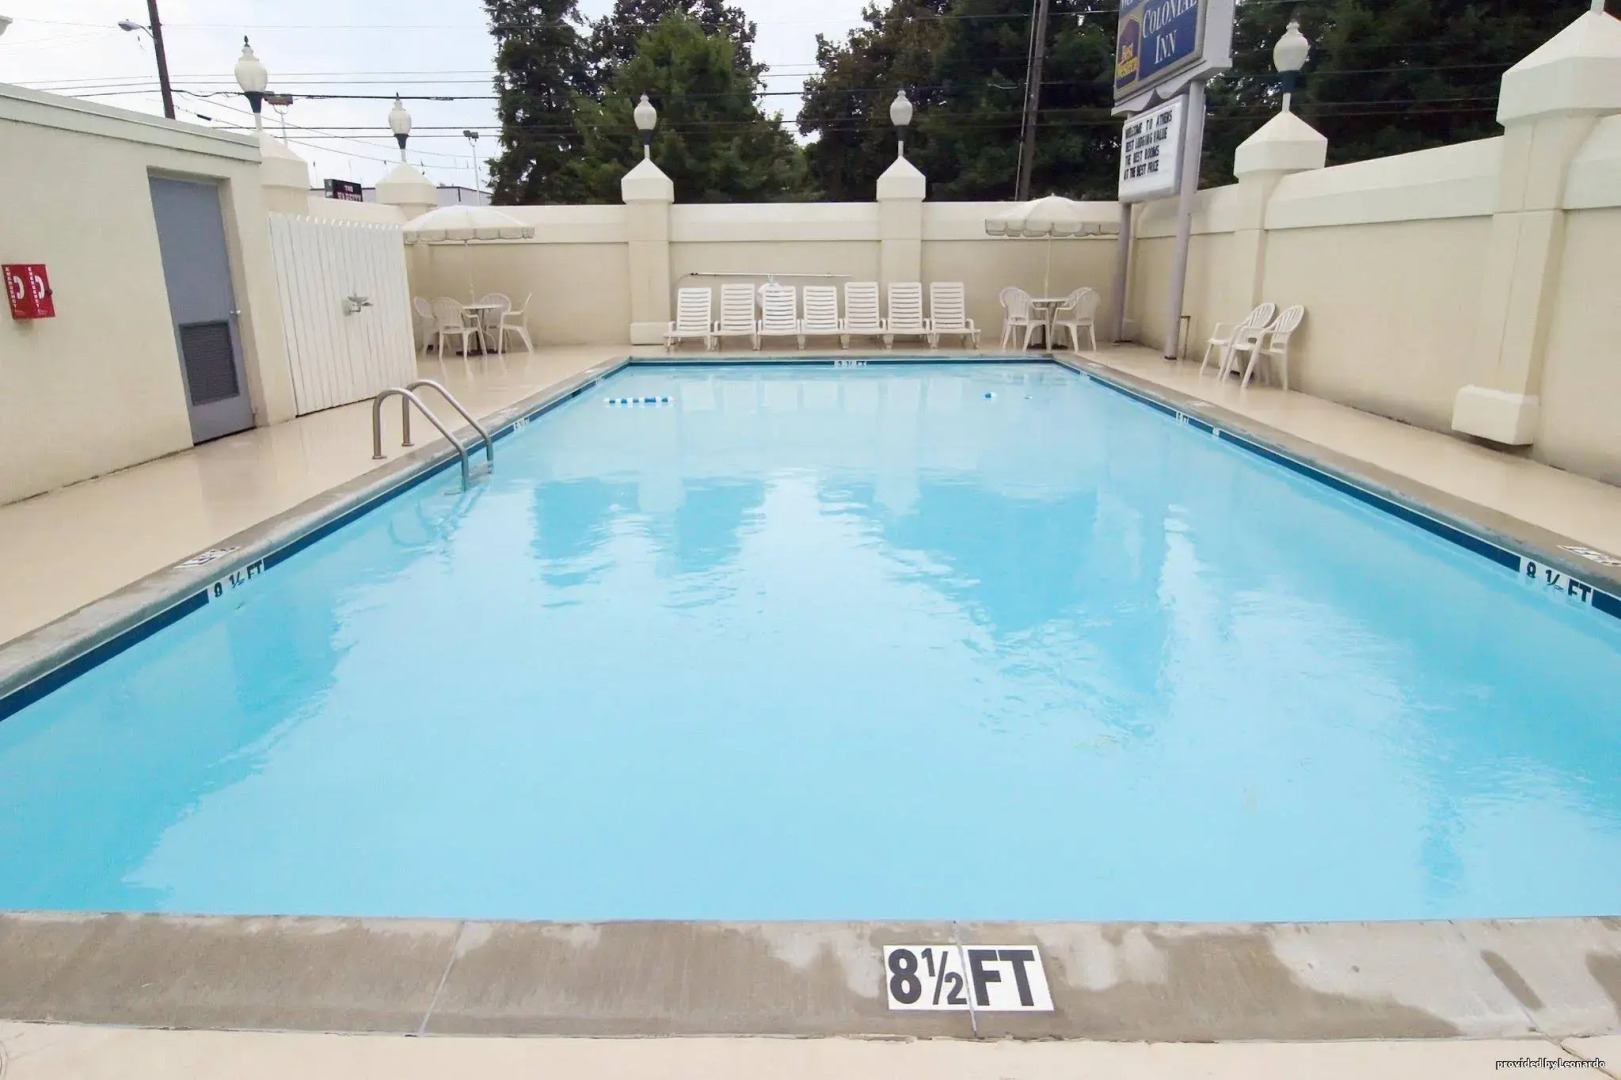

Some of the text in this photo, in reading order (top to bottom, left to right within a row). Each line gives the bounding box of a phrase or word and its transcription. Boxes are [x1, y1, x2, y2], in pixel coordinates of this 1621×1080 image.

[1142, 0, 1197, 38] COLONI
[1155, 29, 1177, 64] INN
[1146, 118, 1153, 132] TO
[1125, 140, 1135, 153] BEST
[1133, 150, 1143, 164] BEST
[1144, 145, 1160, 160] ROOMS
[1136, 163, 1147, 177] BEST
[1147, 160, 1159, 174] PRICE
[246, 560, 263, 580] FT
[1568, 578, 1592, 603] FT
[967, 949, 1036, 1006] FT
